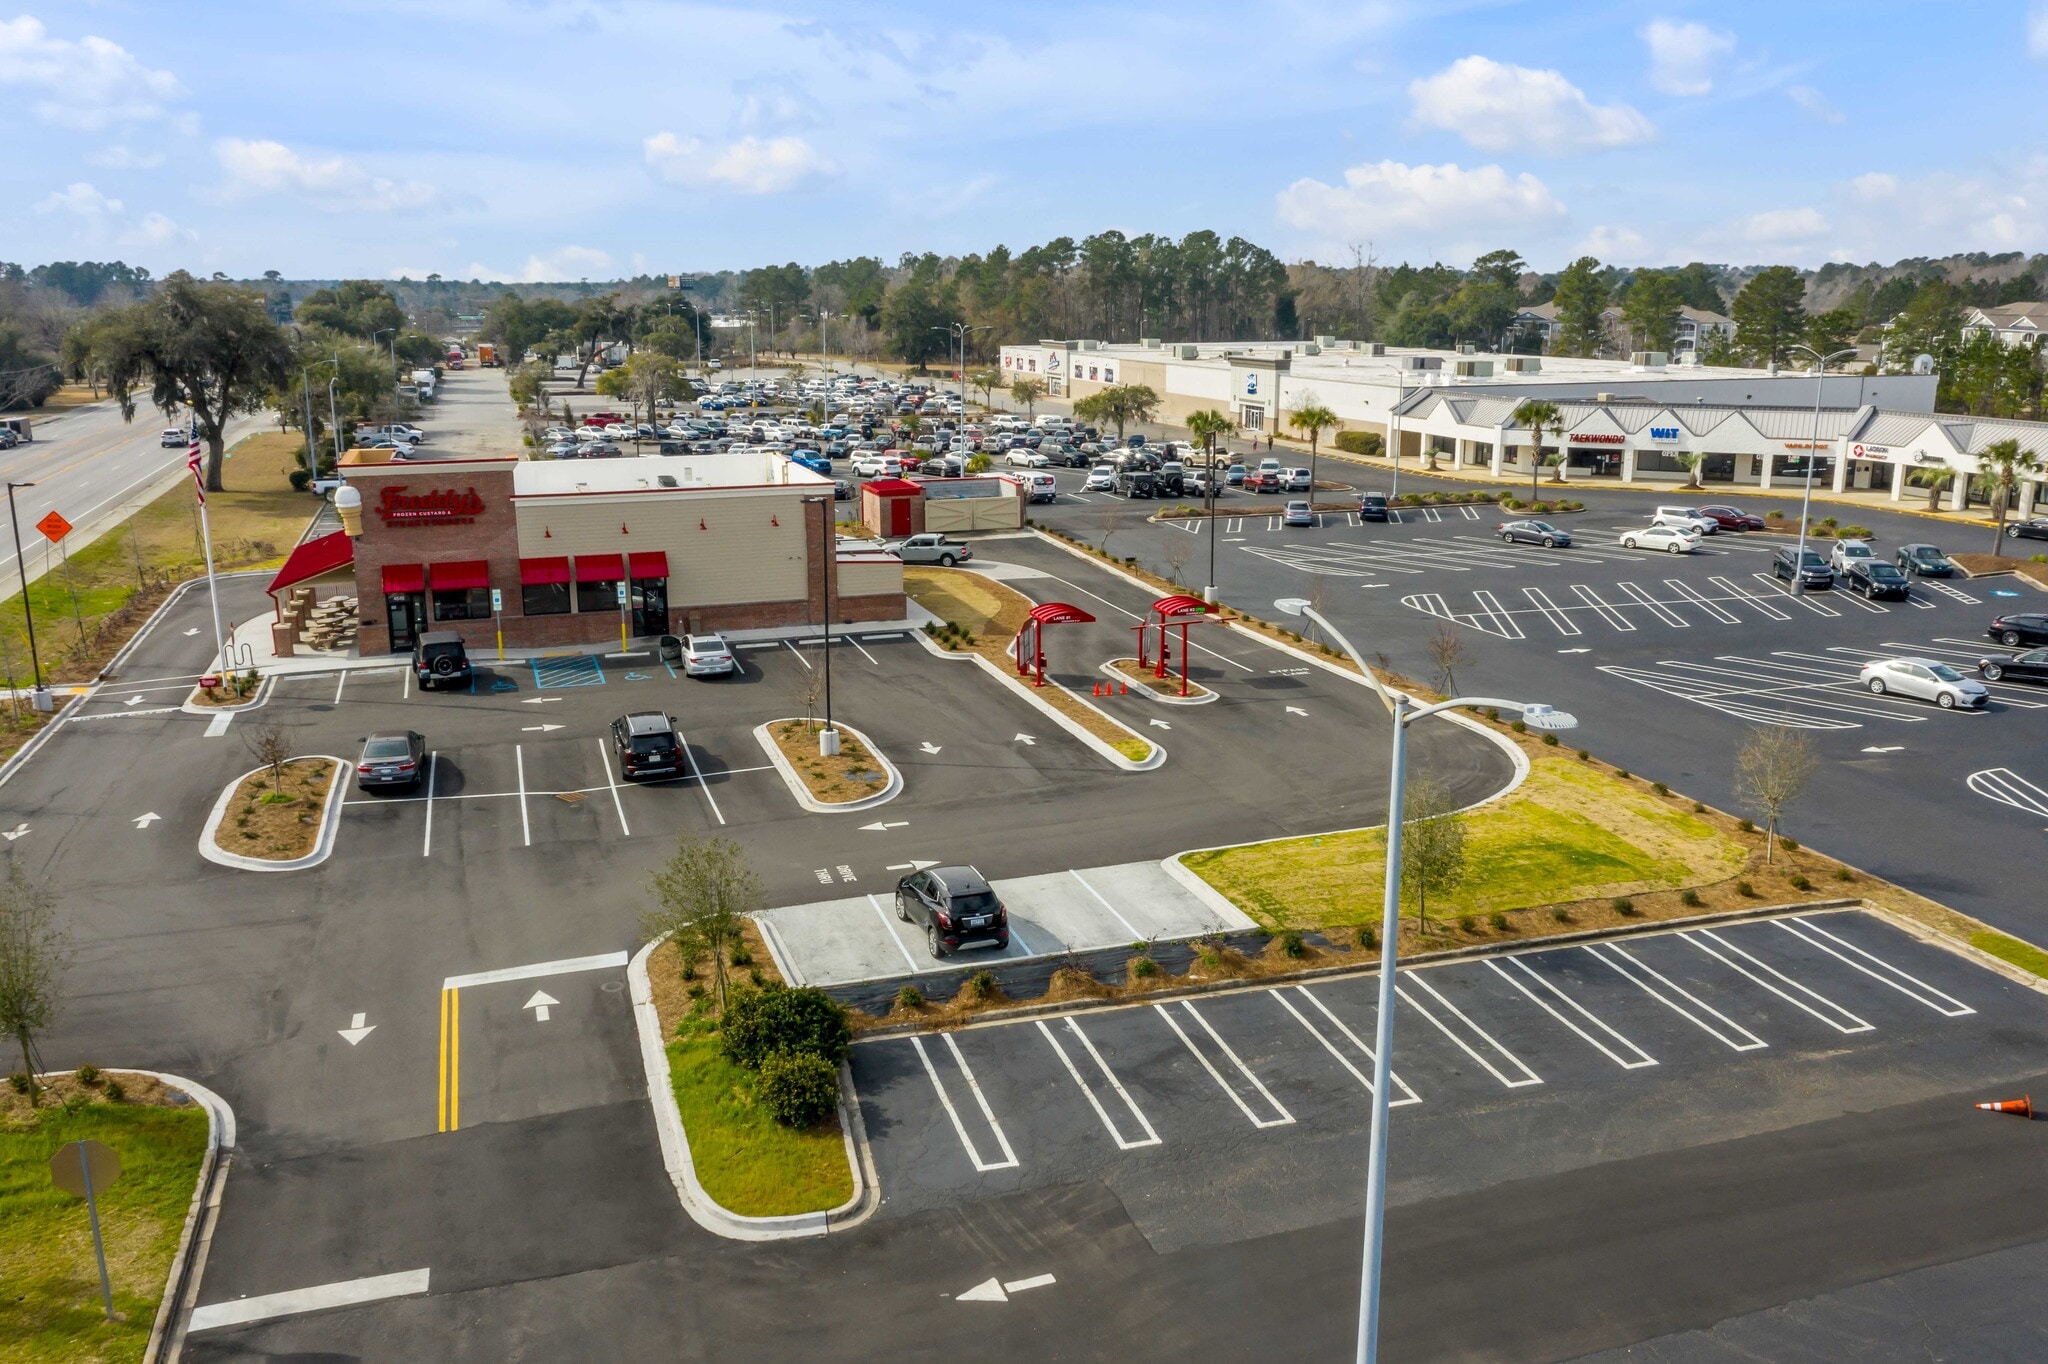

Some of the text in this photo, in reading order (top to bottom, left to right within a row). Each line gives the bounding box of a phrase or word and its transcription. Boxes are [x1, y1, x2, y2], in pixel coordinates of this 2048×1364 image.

[1569, 434, 1625, 444] TAEKWONDO
[1650, 428, 1679, 438] WIT
[375, 486, 486, 518] Freddy's
[814, 868, 834, 883] THRU
[836, 865, 857, 882] DRIVE
